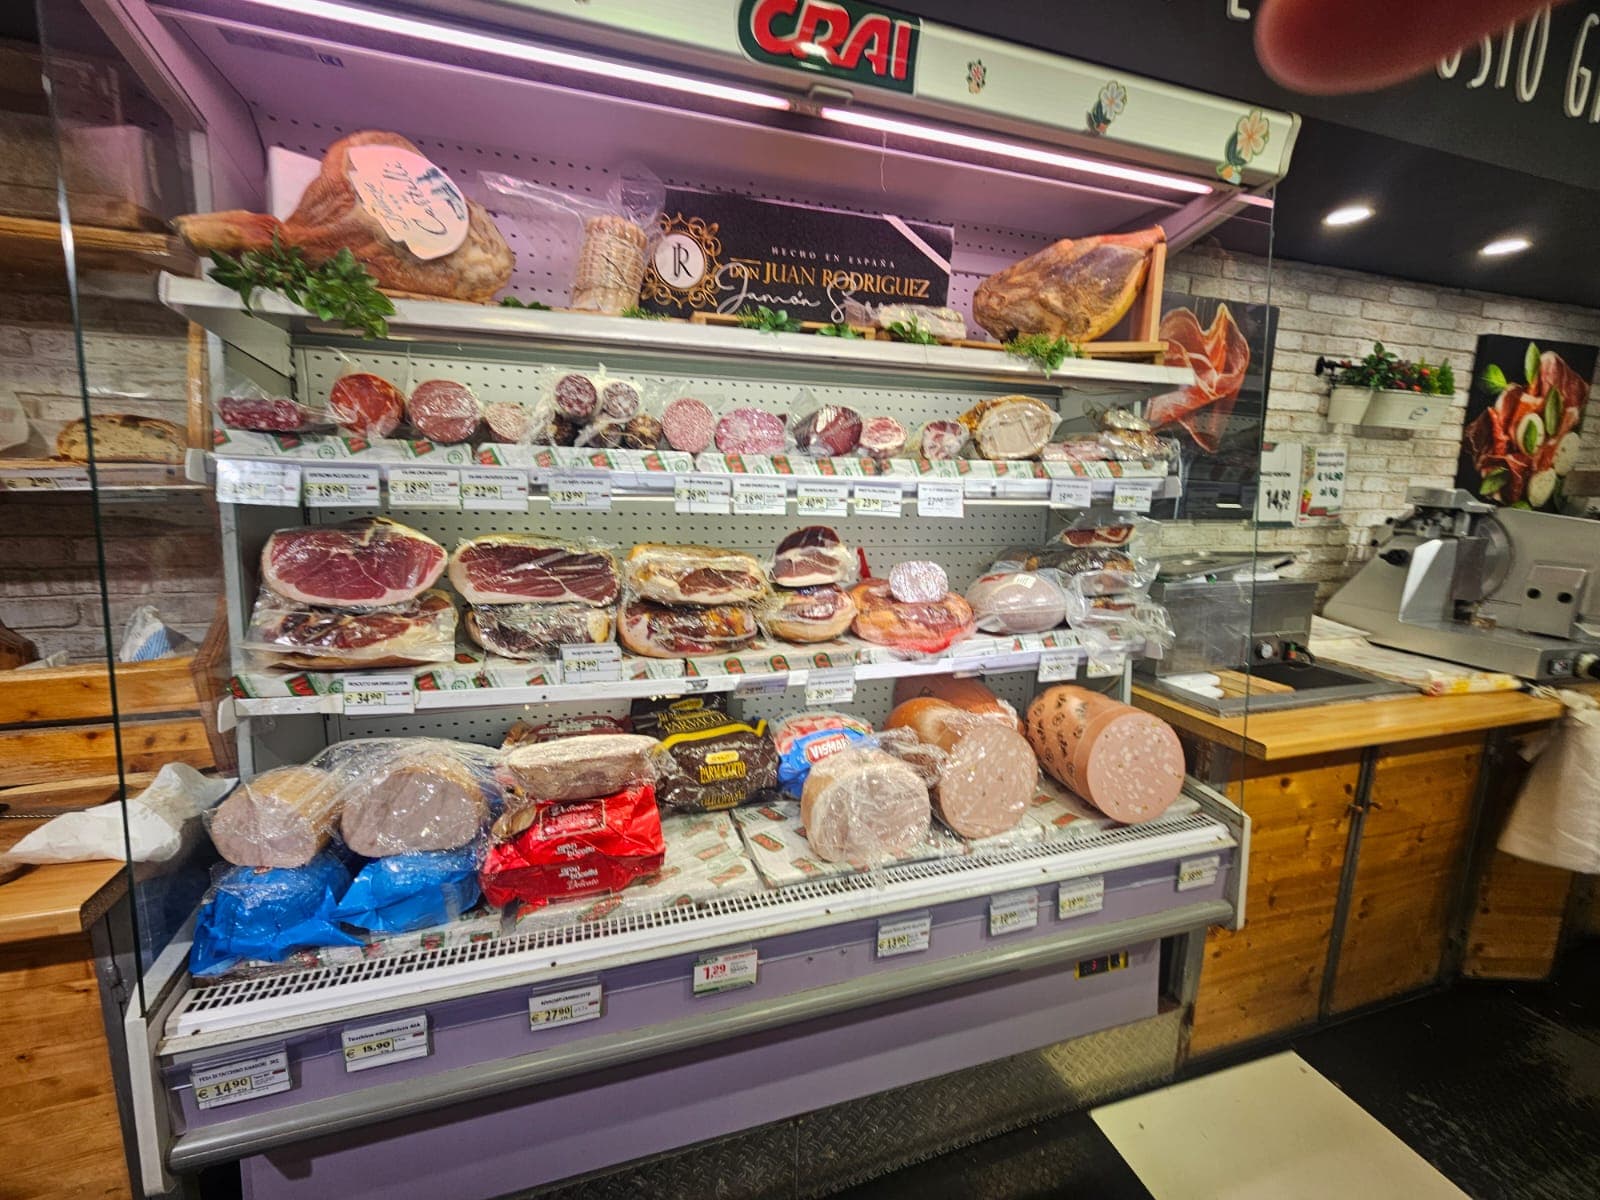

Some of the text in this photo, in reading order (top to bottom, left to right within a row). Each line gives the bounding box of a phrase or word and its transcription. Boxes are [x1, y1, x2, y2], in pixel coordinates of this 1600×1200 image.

[751, 0, 911, 81] CRAI
[771, 245, 817, 260] HECHO
[824, 252, 841, 263] EN
[762, 261, 816, 287] JUAN
[822, 267, 931, 299] RODRIGUEZ
[213, 1077, 248, 1097] 1490
